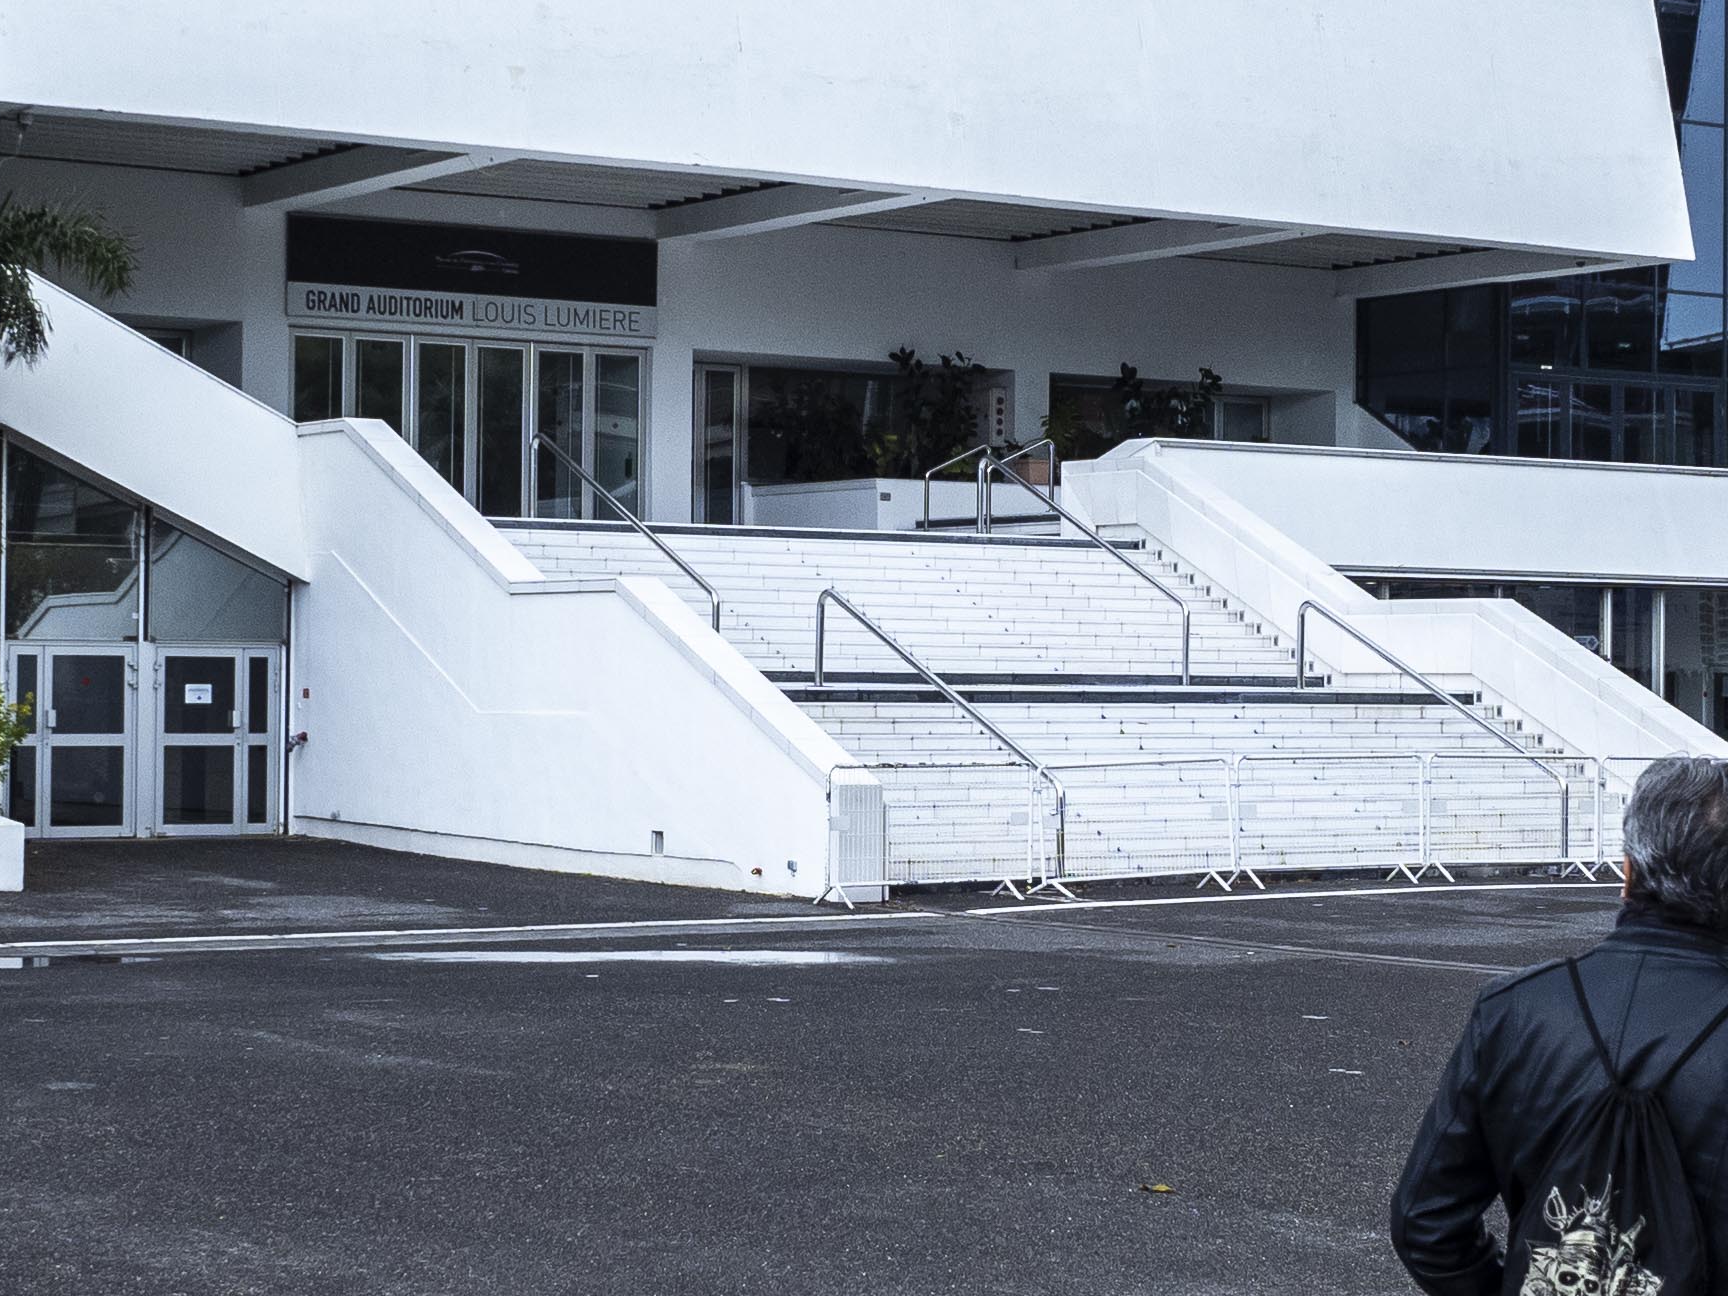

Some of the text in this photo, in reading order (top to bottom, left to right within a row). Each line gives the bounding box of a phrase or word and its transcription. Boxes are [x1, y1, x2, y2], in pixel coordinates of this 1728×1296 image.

[305, 290, 641, 333] GRAND AUDITORIUM LOUIS LUMIERE
